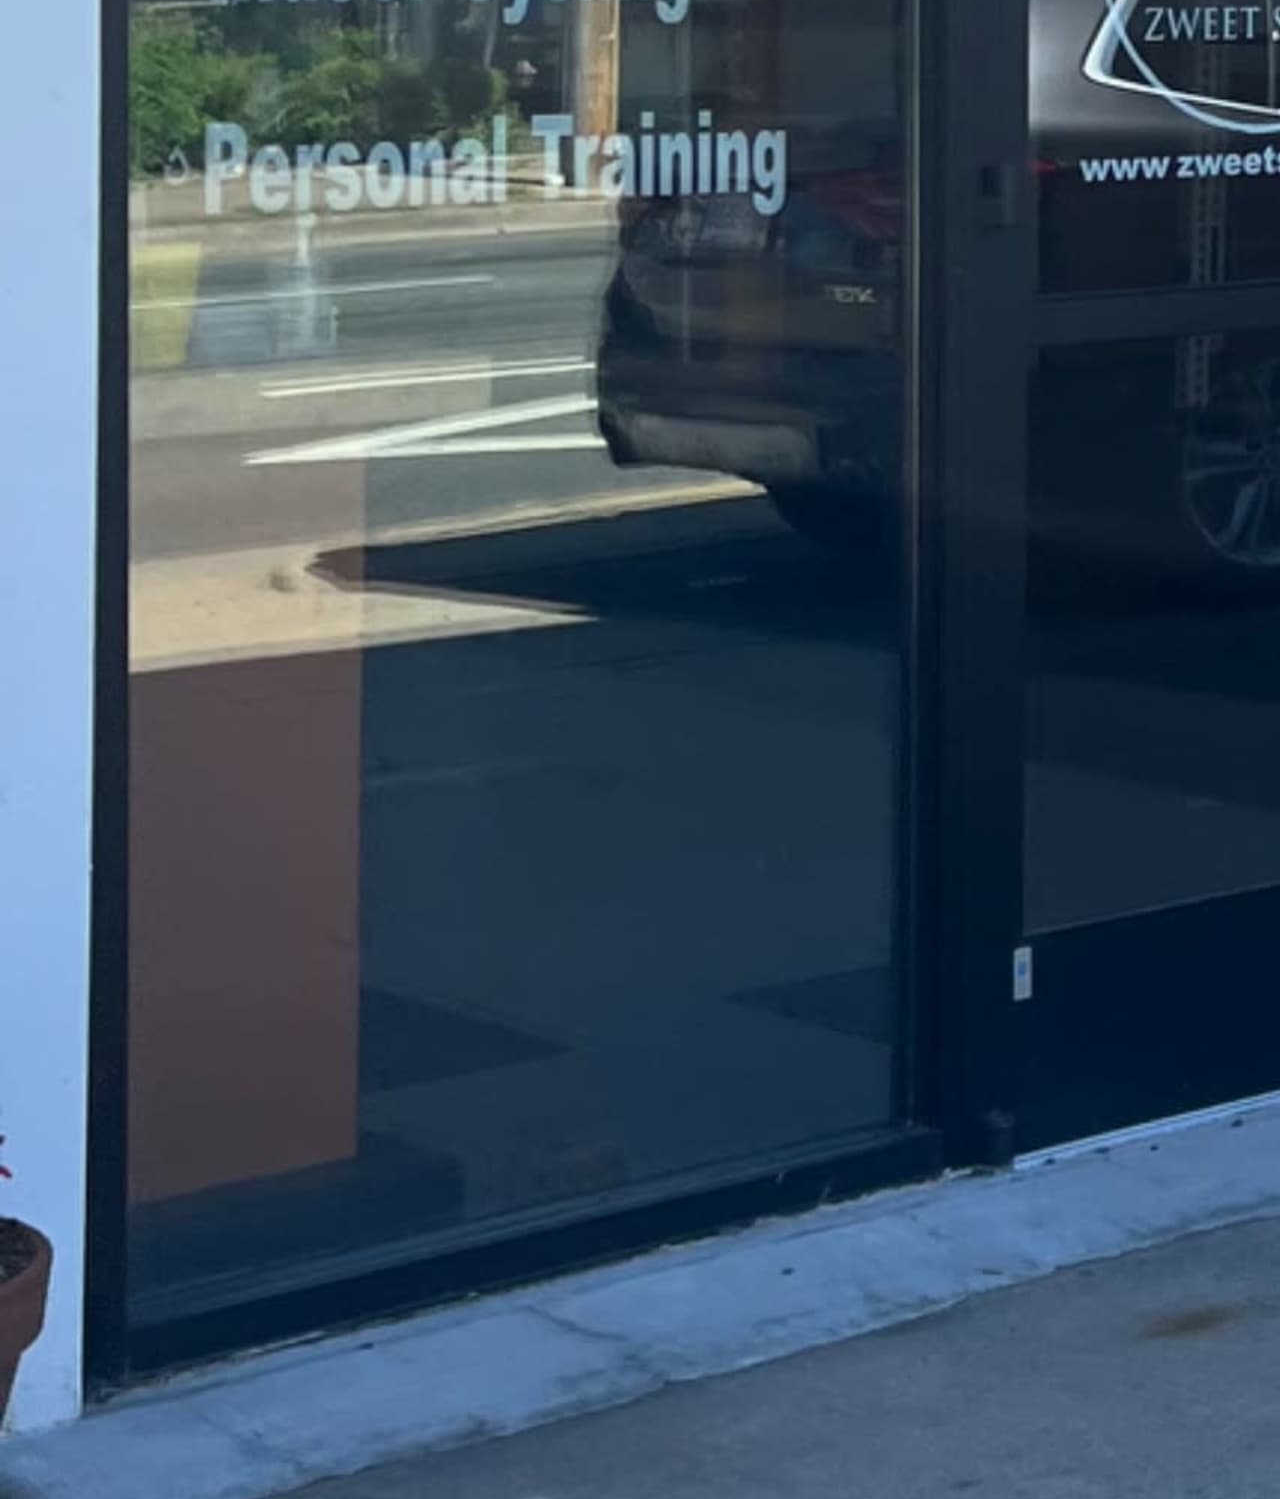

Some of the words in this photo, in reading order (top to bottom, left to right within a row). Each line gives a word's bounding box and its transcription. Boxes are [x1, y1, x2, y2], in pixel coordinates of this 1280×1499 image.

[1144, 6, 1260, 41] ZWEET
[205, 115, 506, 214] Personal
[531, 110, 786, 214] Training
